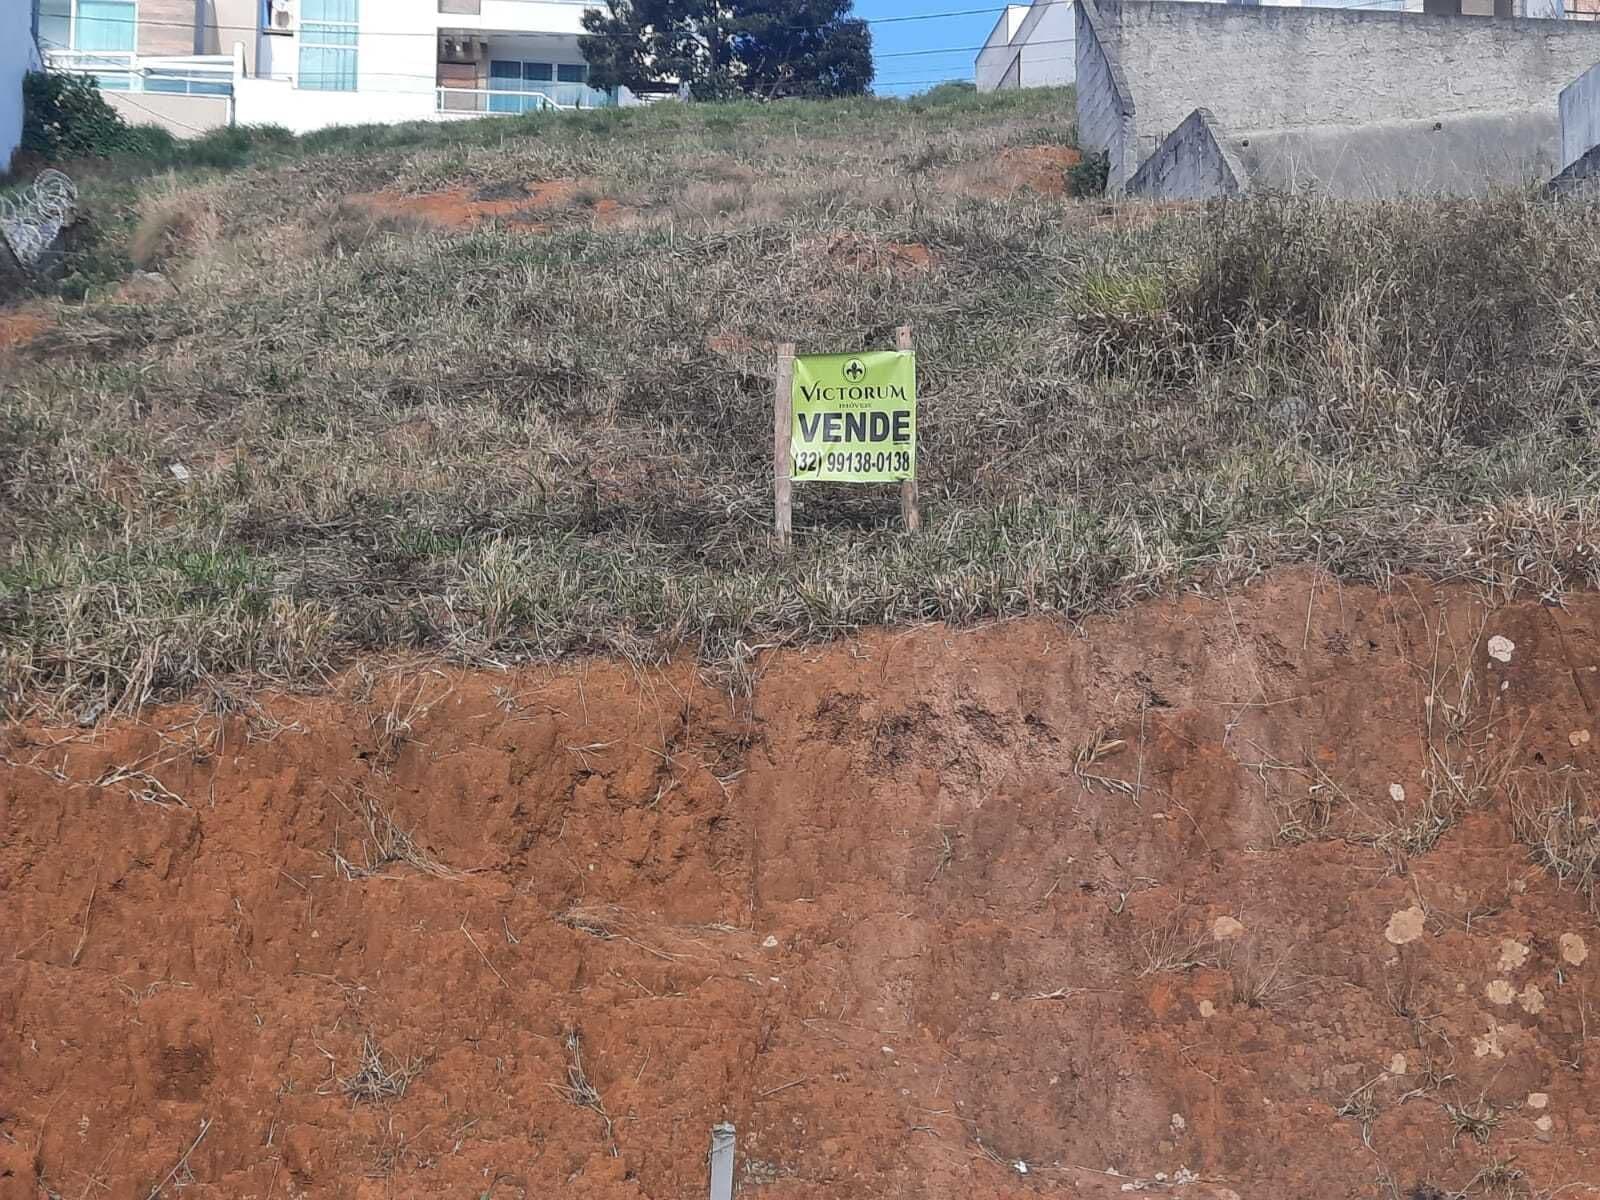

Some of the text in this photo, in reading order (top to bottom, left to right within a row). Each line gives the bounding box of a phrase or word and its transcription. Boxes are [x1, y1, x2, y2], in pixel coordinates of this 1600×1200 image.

[800, 380, 907, 402] VICTORUM
[798, 411, 910, 443] VENDE
[794, 451, 910, 477] (32) 99138-0138
